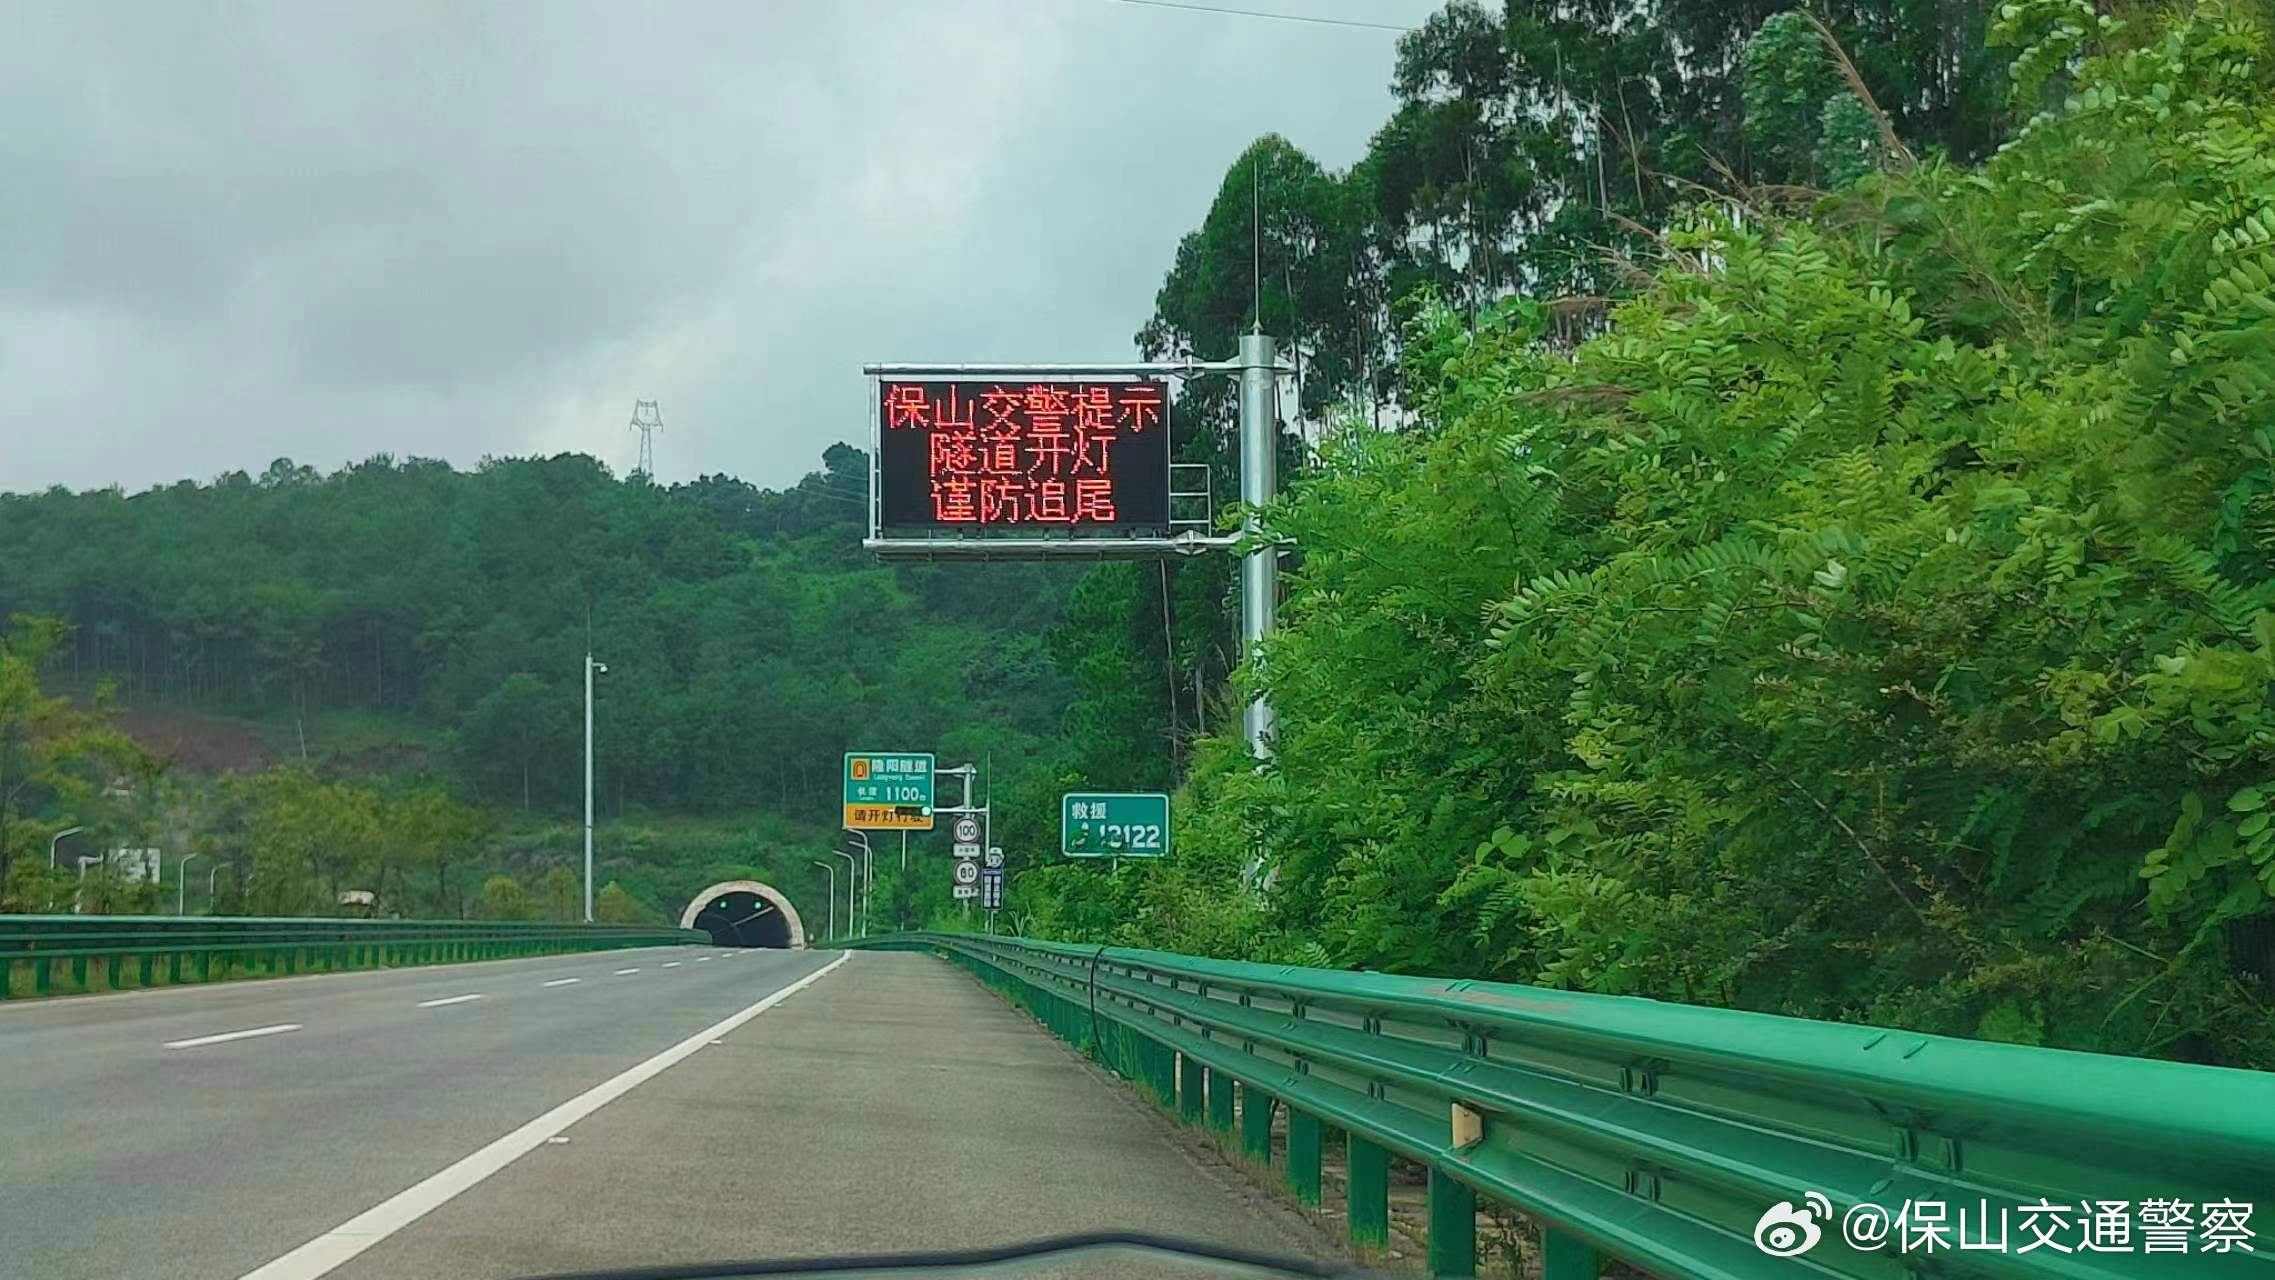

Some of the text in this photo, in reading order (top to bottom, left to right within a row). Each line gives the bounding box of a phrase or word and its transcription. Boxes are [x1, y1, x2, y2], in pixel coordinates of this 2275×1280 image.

[883, 384, 1161, 433] 保山交警提示
[930, 430, 1117, 476] 隧道开灯
[930, 477, 1116, 523] 谨防追尾
[959, 825, 976, 837] 100
[1071, 802, 1107, 819] 救援
